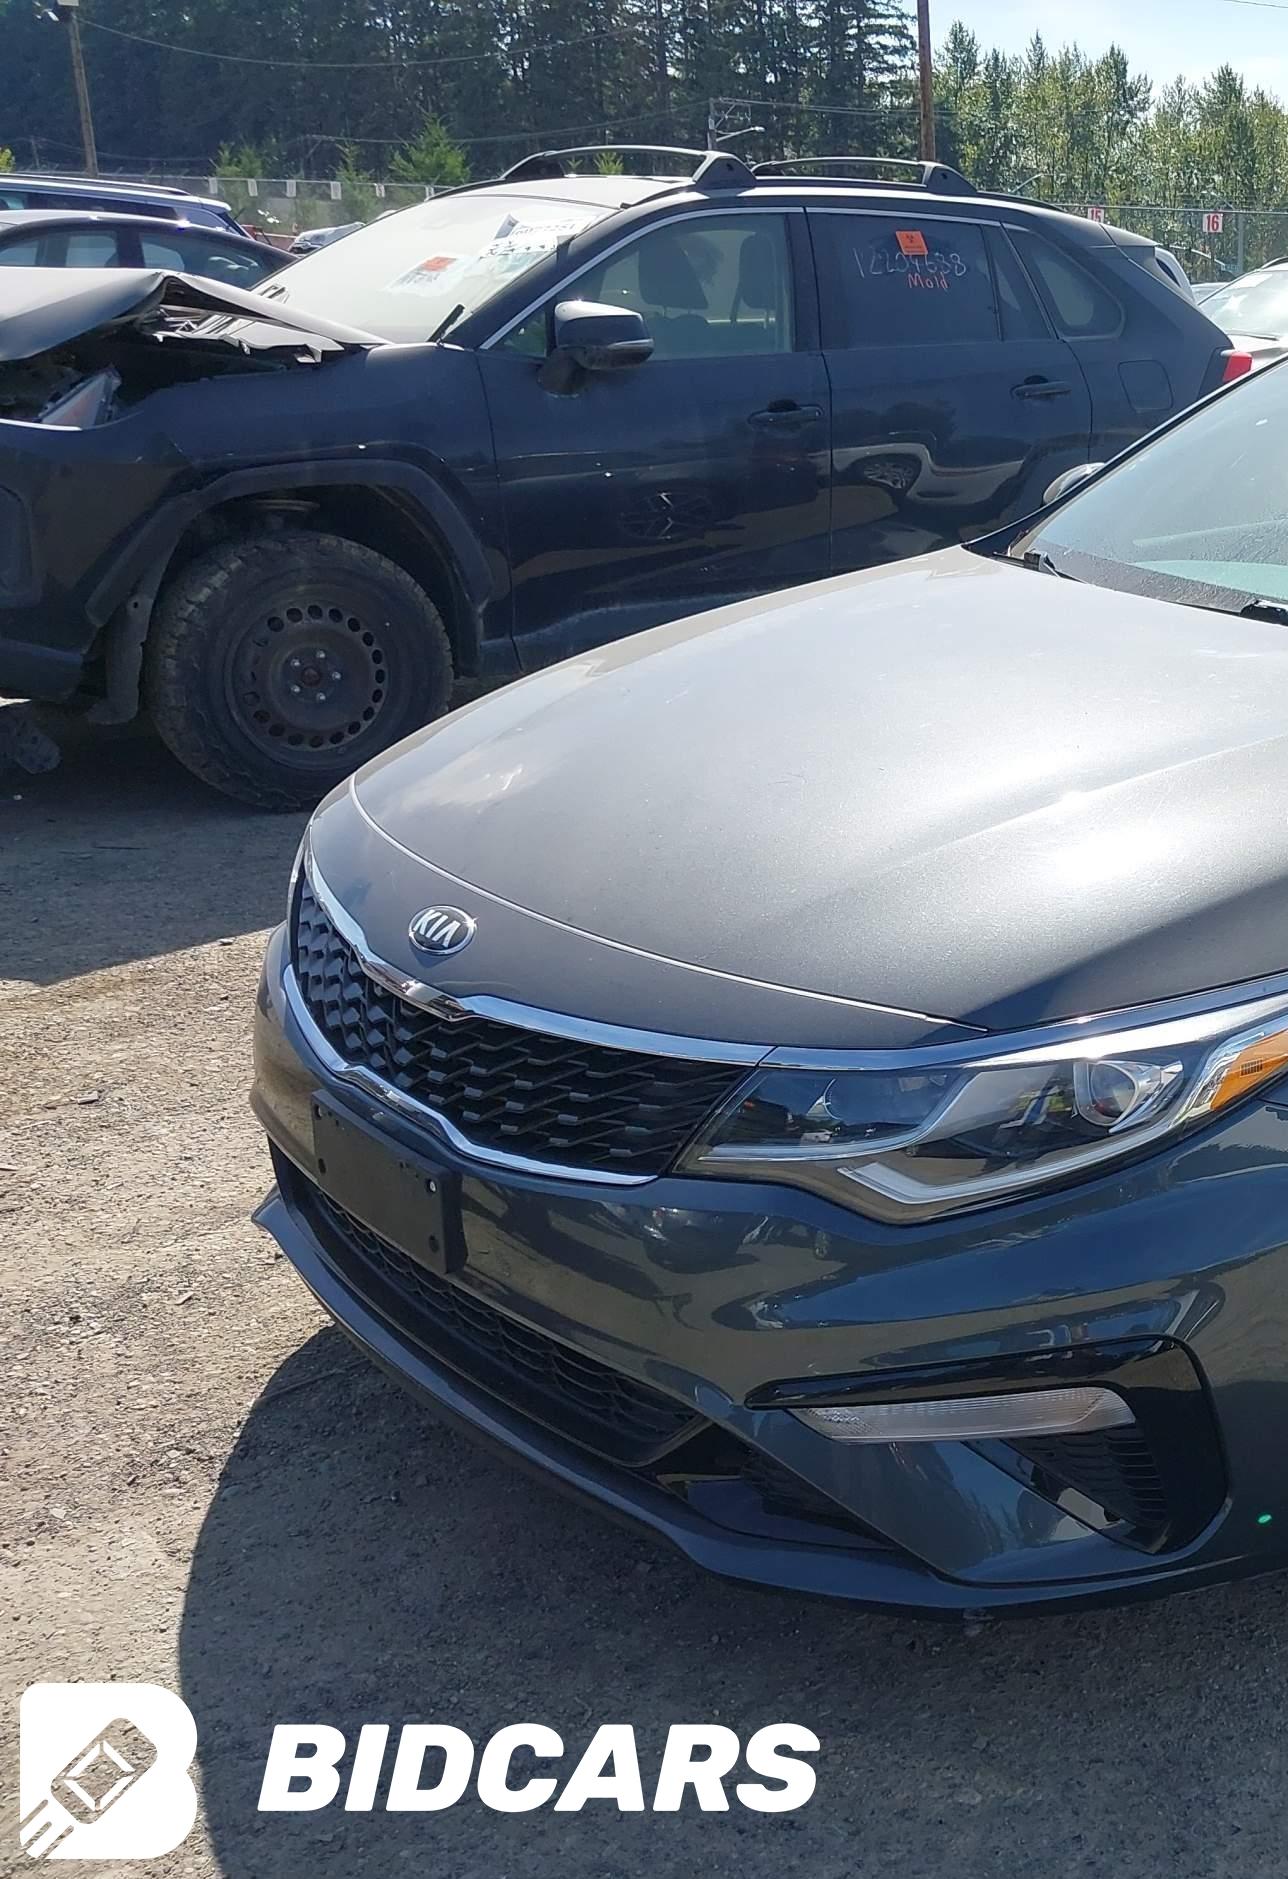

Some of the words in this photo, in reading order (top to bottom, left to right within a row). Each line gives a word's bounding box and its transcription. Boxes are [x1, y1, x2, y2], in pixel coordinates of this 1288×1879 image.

[1206, 214, 1219, 231] 16
[907, 272, 949, 290] Mold
[412, 909, 461, 948] KIA
